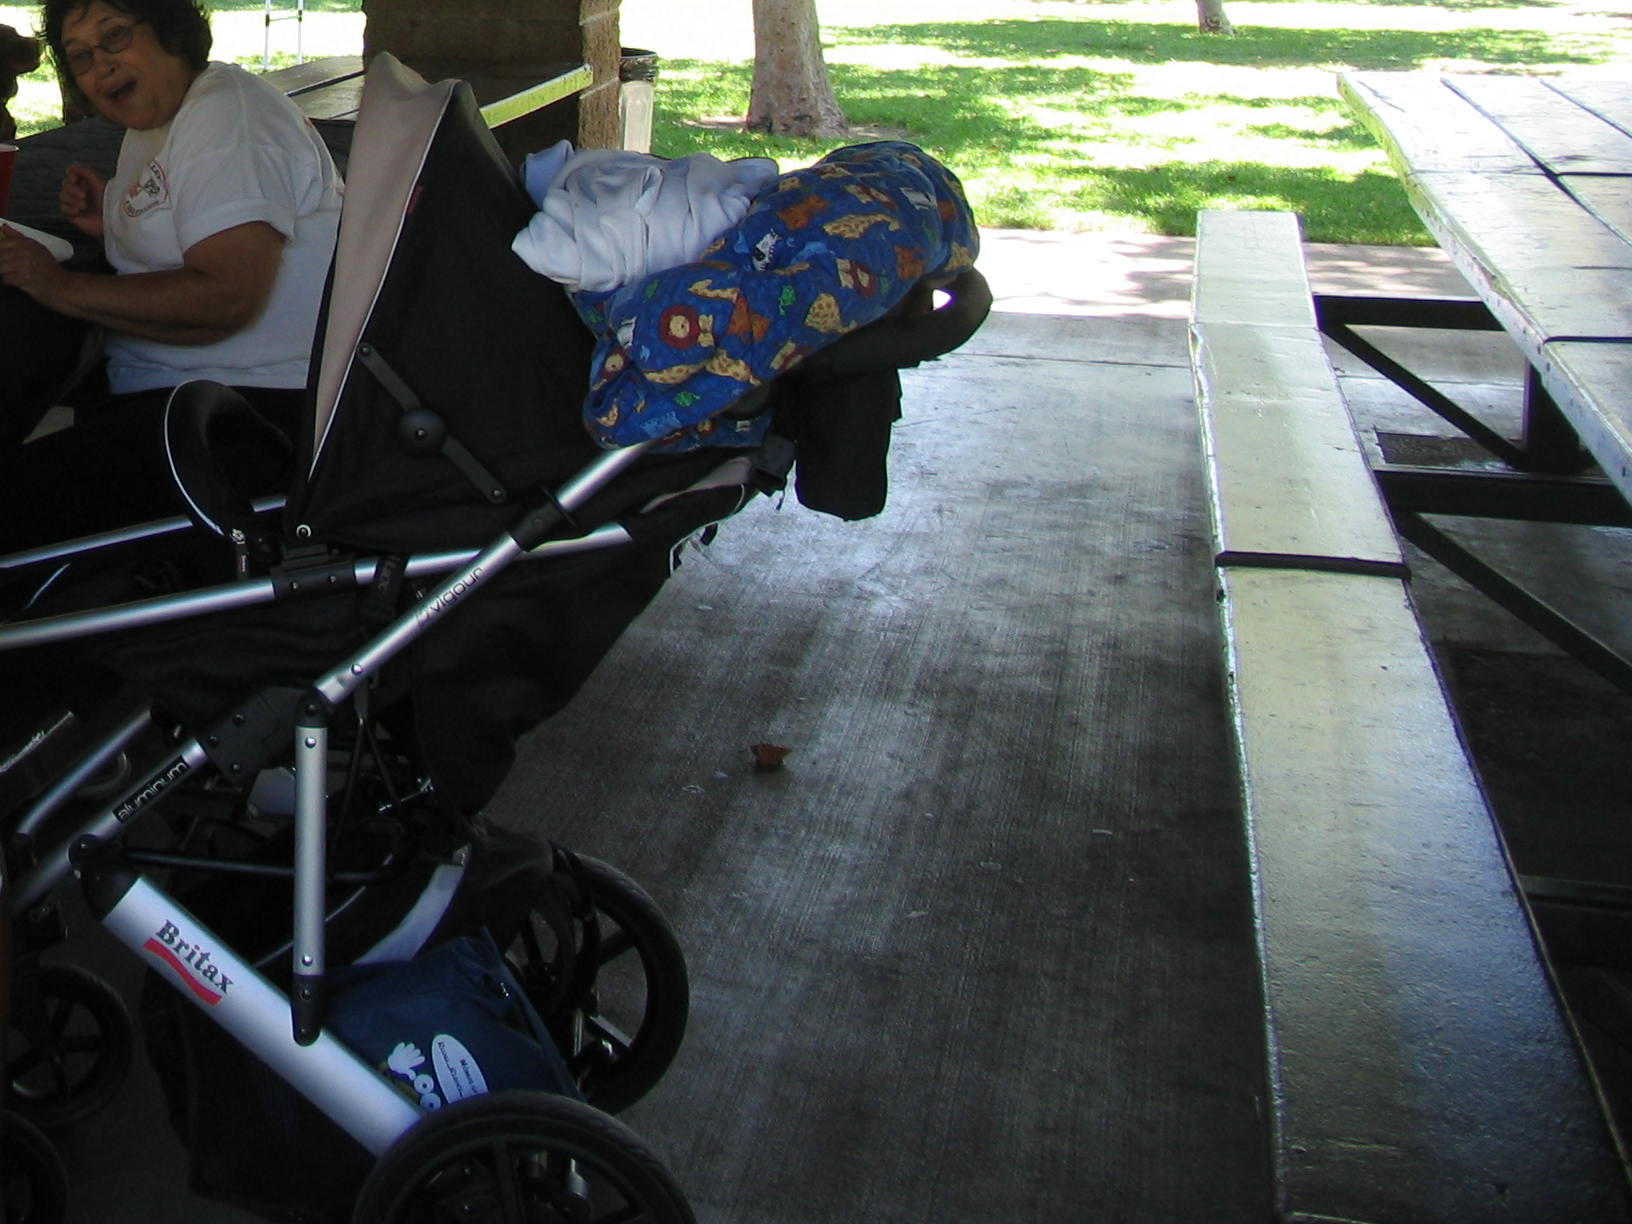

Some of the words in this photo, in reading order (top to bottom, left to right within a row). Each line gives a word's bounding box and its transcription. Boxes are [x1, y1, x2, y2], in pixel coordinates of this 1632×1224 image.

[431, 567, 484, 613] vigour
[118, 762, 188, 819] aluminum
[155, 918, 235, 995] Britax
